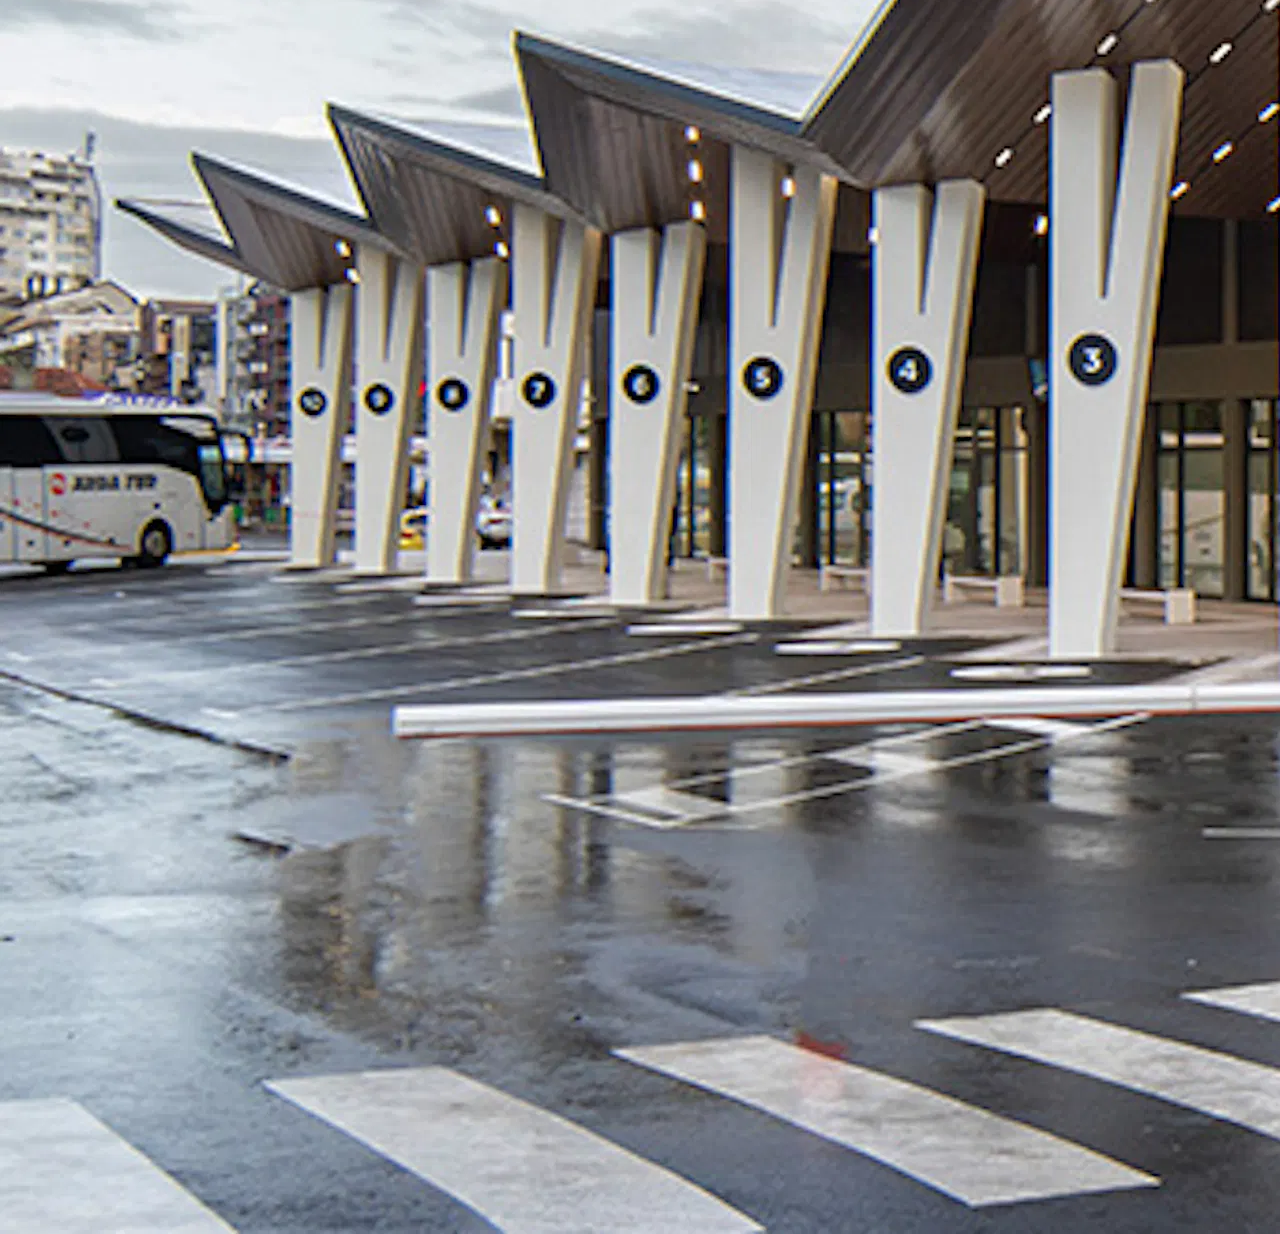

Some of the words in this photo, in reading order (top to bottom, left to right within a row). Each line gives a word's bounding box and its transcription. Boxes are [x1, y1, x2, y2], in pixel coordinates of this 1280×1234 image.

[897, 358, 918, 382] 4
[1082, 346, 1105, 374] 3
[632, 373, 649, 396] 6
[753, 366, 772, 389] 5
[530, 380, 546, 400] 7
